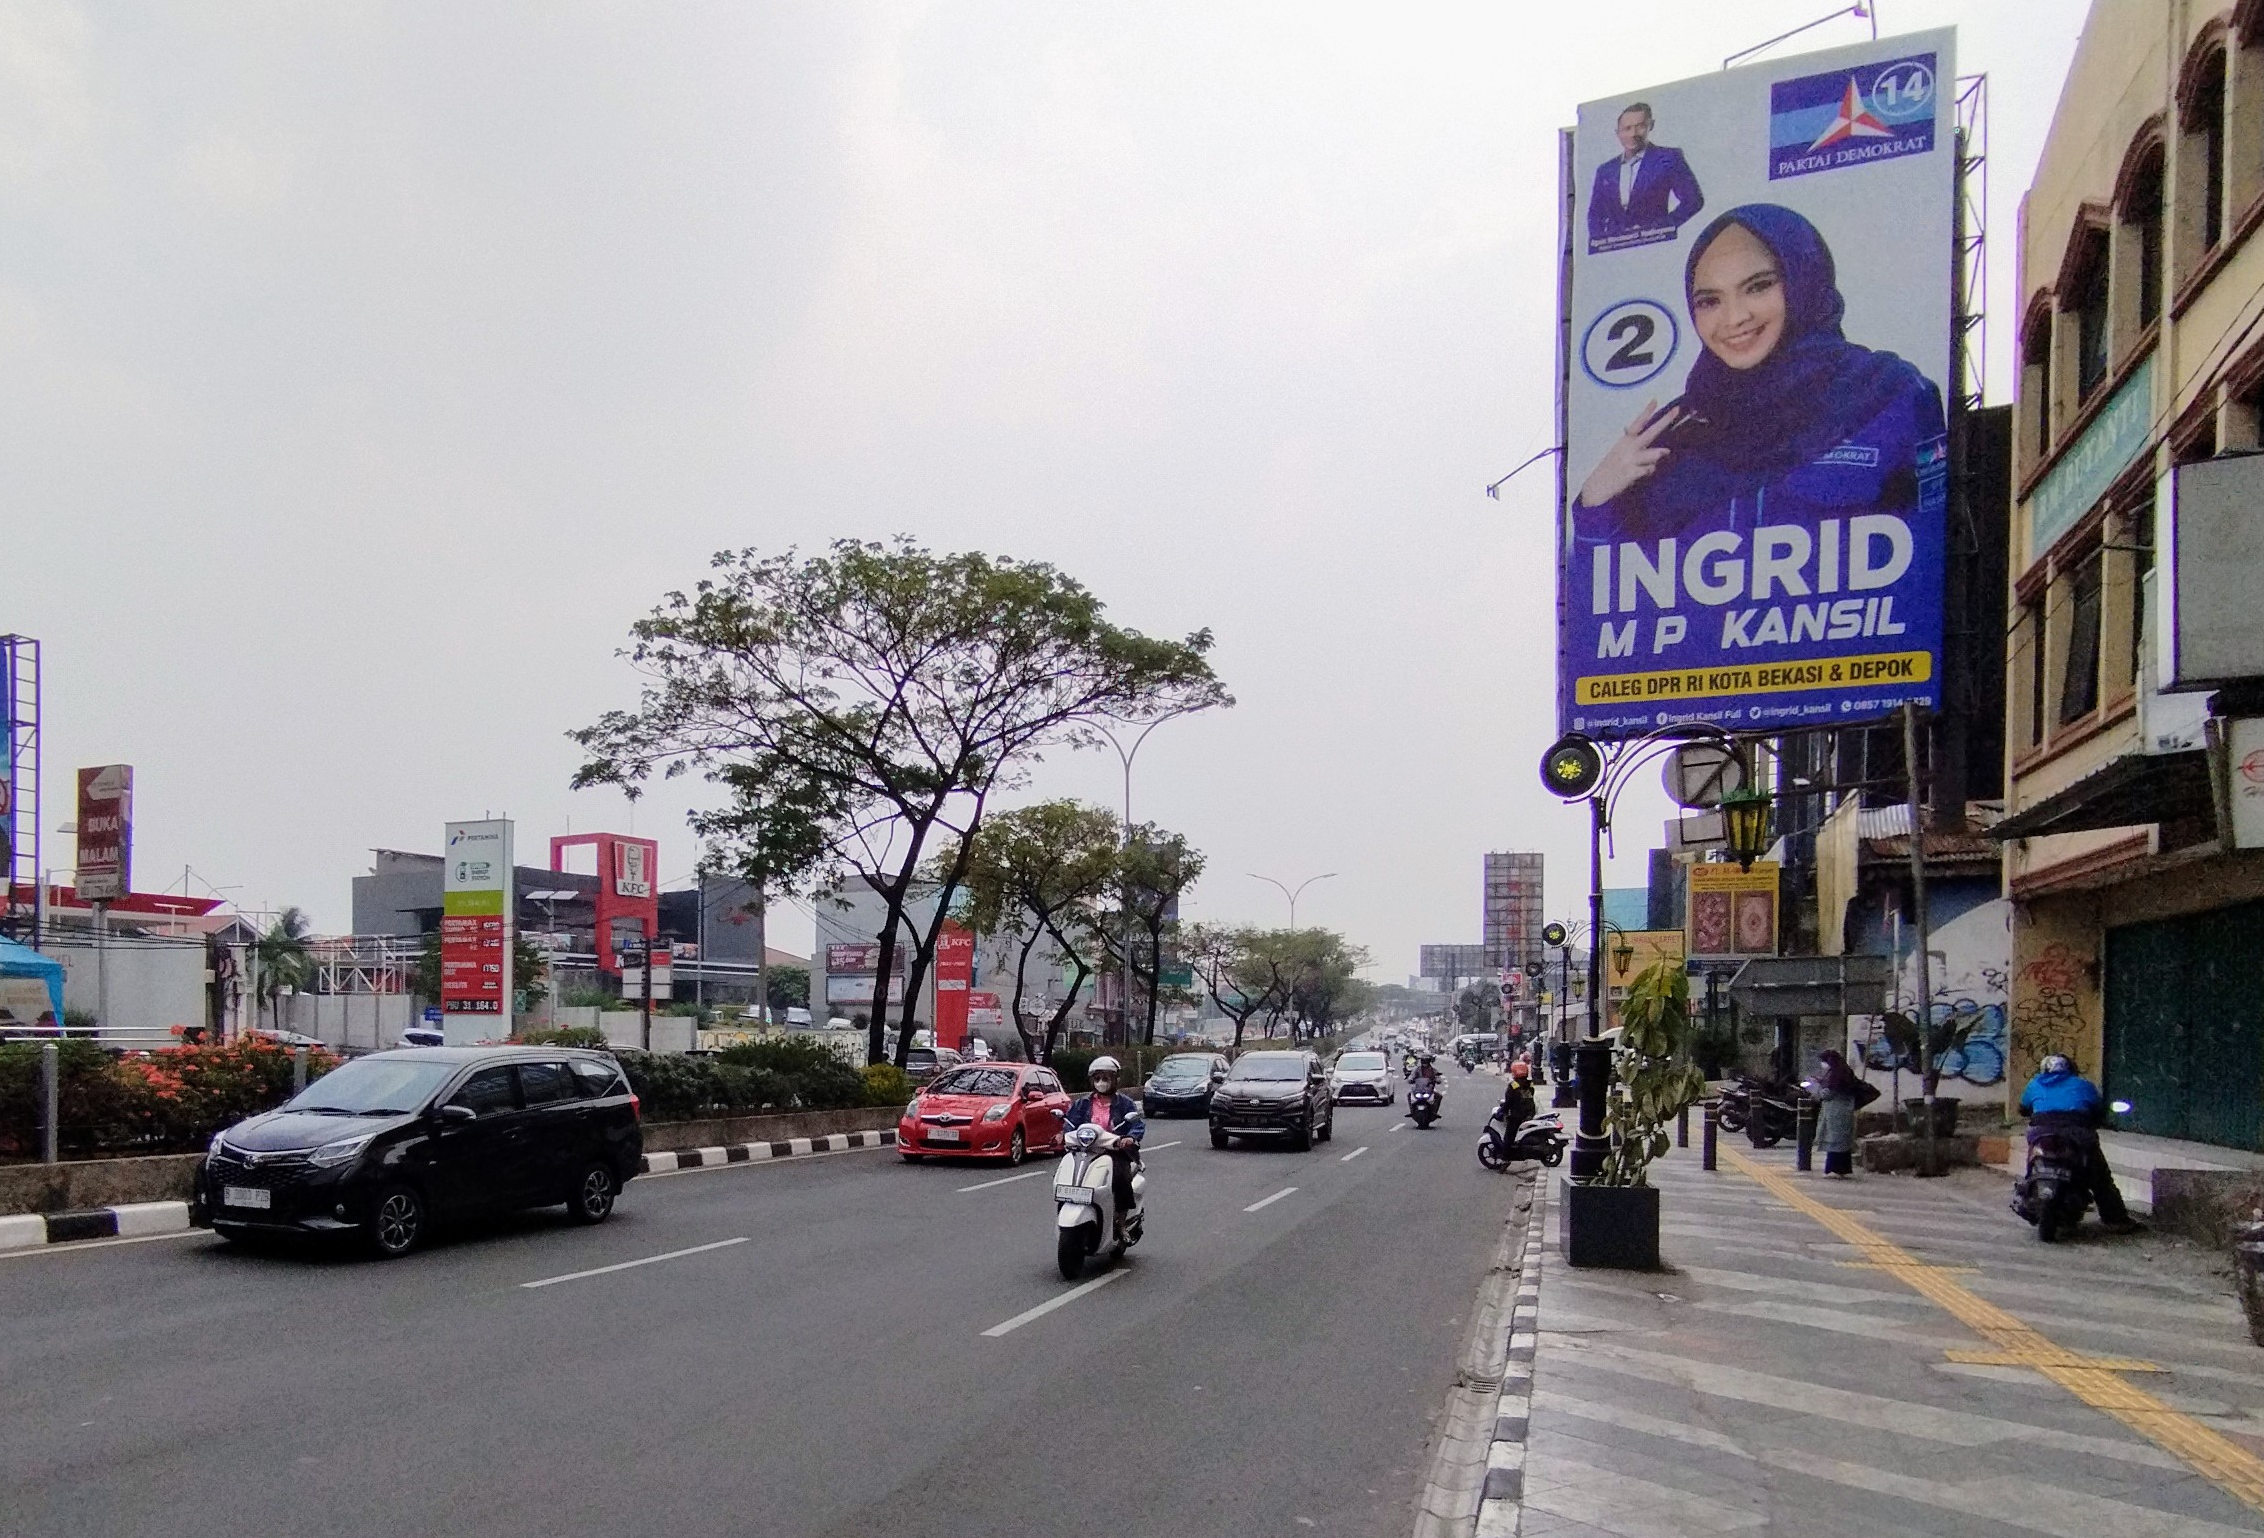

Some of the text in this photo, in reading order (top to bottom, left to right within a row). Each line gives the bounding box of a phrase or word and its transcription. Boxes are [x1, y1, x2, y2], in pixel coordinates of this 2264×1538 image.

[1881, 71, 1925, 106] 14
[1778, 135, 1927, 175] PARTAI DEMOKRAT
[1605, 315, 1655, 371] 2
[1592, 513, 1915, 615] INGRID
[1597, 595, 1906, 659] M P KANSIL
[1589, 658, 1914, 699] CALEG DPR RI KOTA BEKASI & DEPOK
[88, 816, 119, 833] BUKA
[79, 846, 119, 863] MALAM
[621, 881, 645, 894] KFC
[951, 938, 971, 947] KFC
